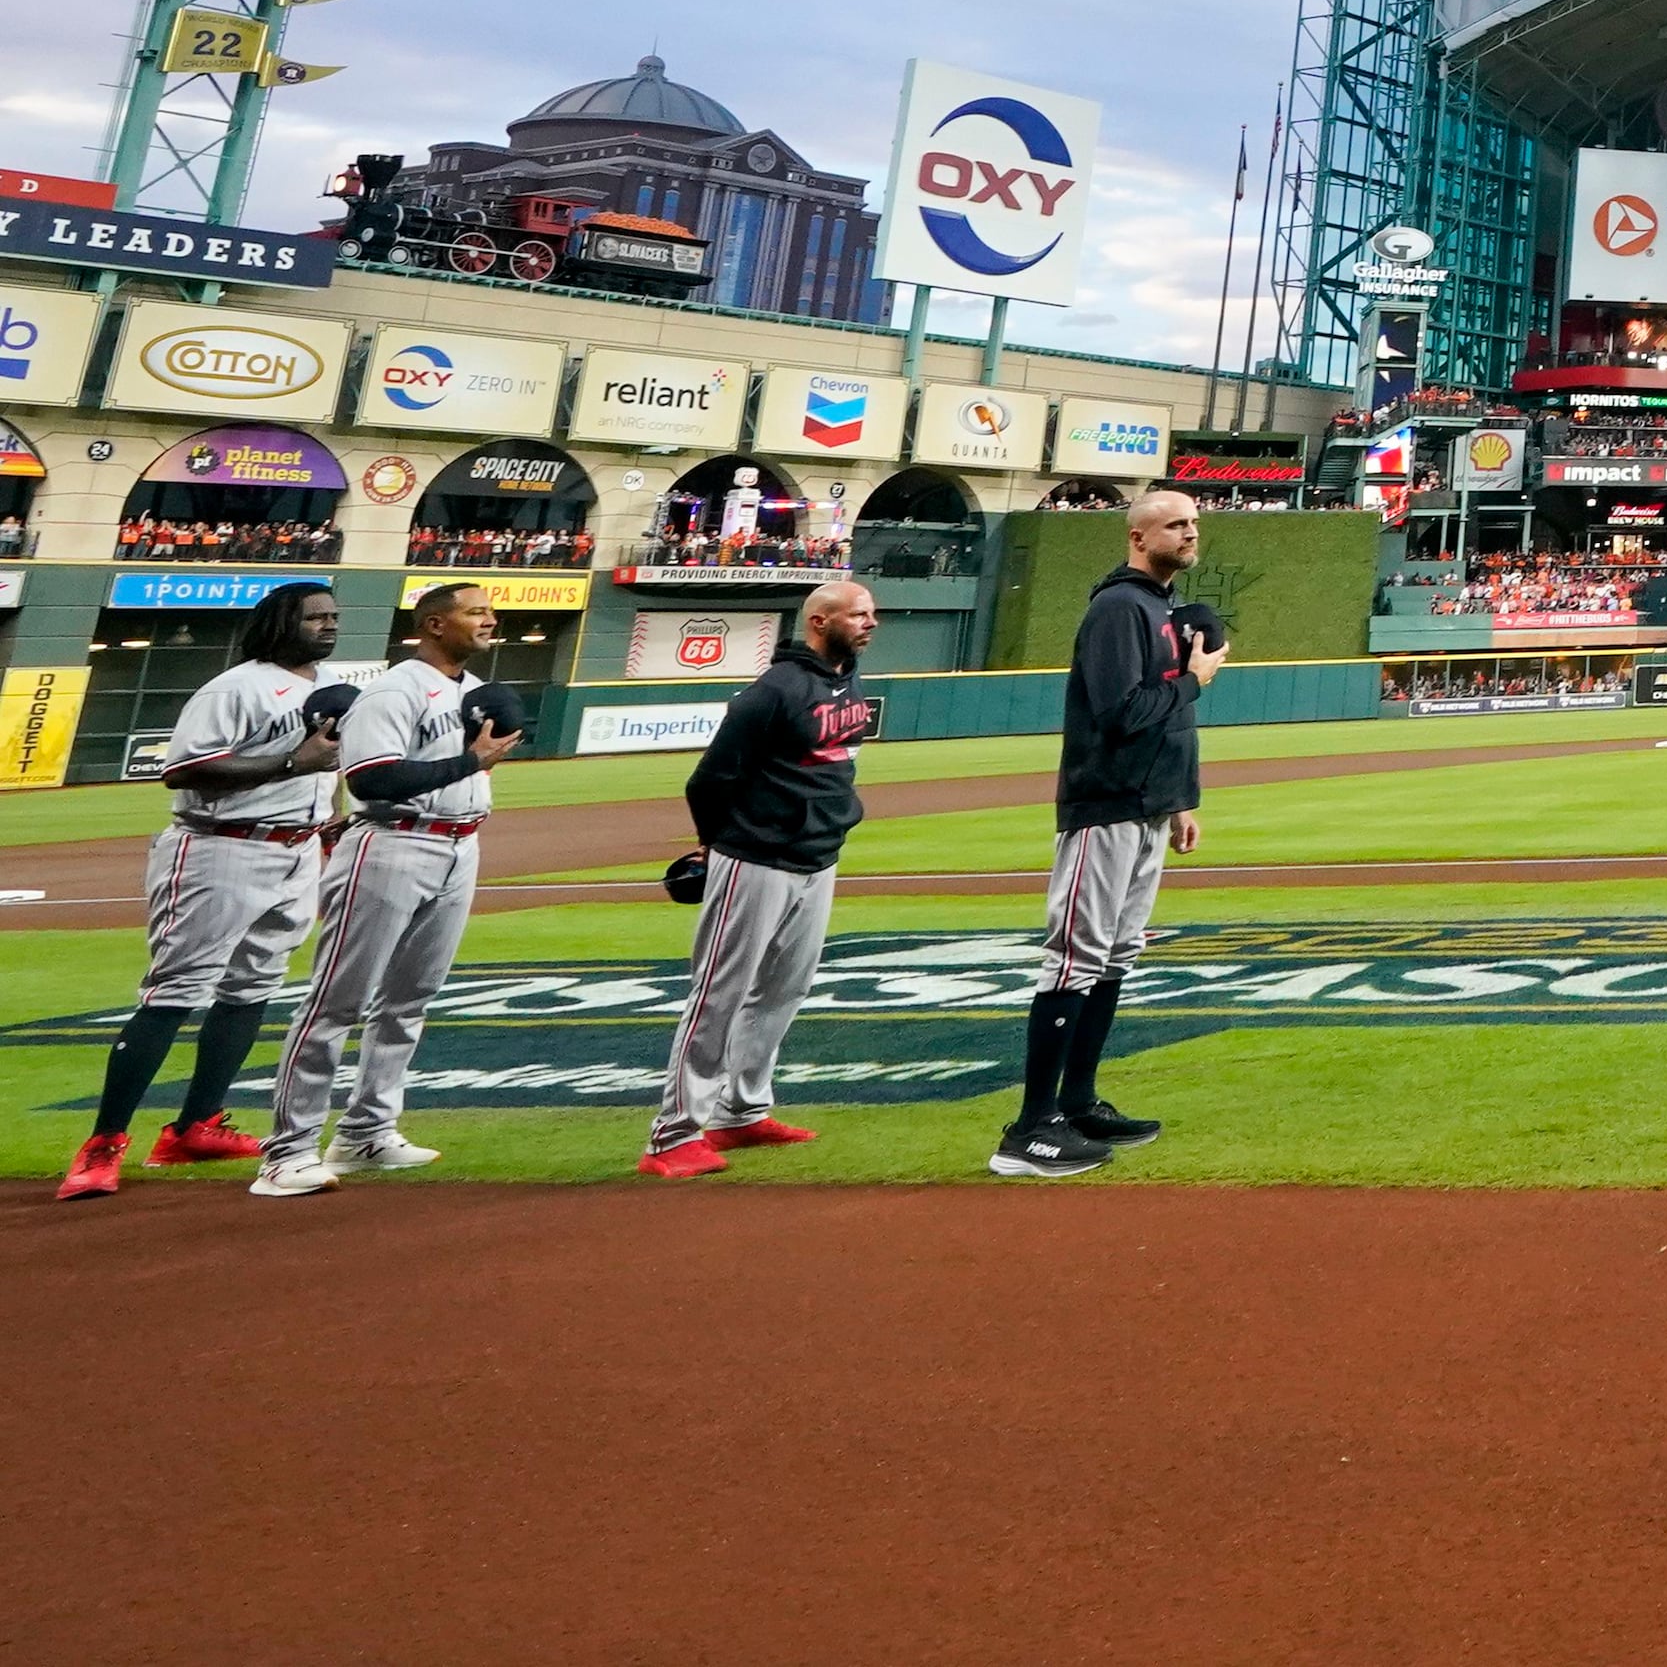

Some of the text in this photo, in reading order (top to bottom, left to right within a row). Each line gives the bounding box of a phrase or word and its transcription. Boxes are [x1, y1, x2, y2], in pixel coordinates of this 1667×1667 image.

[192, 30, 243, 58] 22
[918, 151, 1076, 216] OXY
[48, 218, 298, 271] LEADERS
[618, 241, 670, 263] SLOVACEK'S
[1352, 262, 1449, 283] Gallagher
[1359, 282, 1439, 297] INSURANCE
[166, 340, 297, 386] COTTON
[383, 367, 454, 388] OXY
[466, 375, 513, 394] ZERO
[810, 376, 869, 394] Chevron
[603, 378, 710, 411] reliant
[1569, 394, 1640, 408] HORNITOS
[598, 416, 705, 437] an NRG company
[1069, 428, 1150, 446] FREEPORT
[1098, 422, 1160, 456] LNG
[90, 443, 111, 457] 24
[224, 445, 303, 467] planet
[952, 442, 1009, 460] QUANTA
[192, 454, 213, 472] pf
[1170, 456, 1305, 481] Budweiser
[230, 462, 313, 484] fitness
[624, 474, 643, 486] DK
[1564, 465, 1642, 484] impact
[1611, 504, 1662, 517] Budweiser
[1607, 516, 1665, 526] BREW HOUSE
[660, 569, 727, 580] PROVIDING
[730, 569, 774, 581] ENERGY.
[776, 570, 824, 582] IMPROVING
[516, 586, 578, 604] JOHN'S
[1550, 613, 1612, 626] #HITTHEBUDS
[686, 625, 724, 635] PHILLIPS
[684, 639, 722, 660] 66
[1447, 701, 1481, 712] NETWORK
[1517, 699, 1550, 709] NETWORK
[1585, 696, 1617, 706] NETWORK
[16, 673, 55, 773] DOGGETT
[619, 715, 719, 742] Insperity
[1026, 1141, 1063, 1159] HOKA
